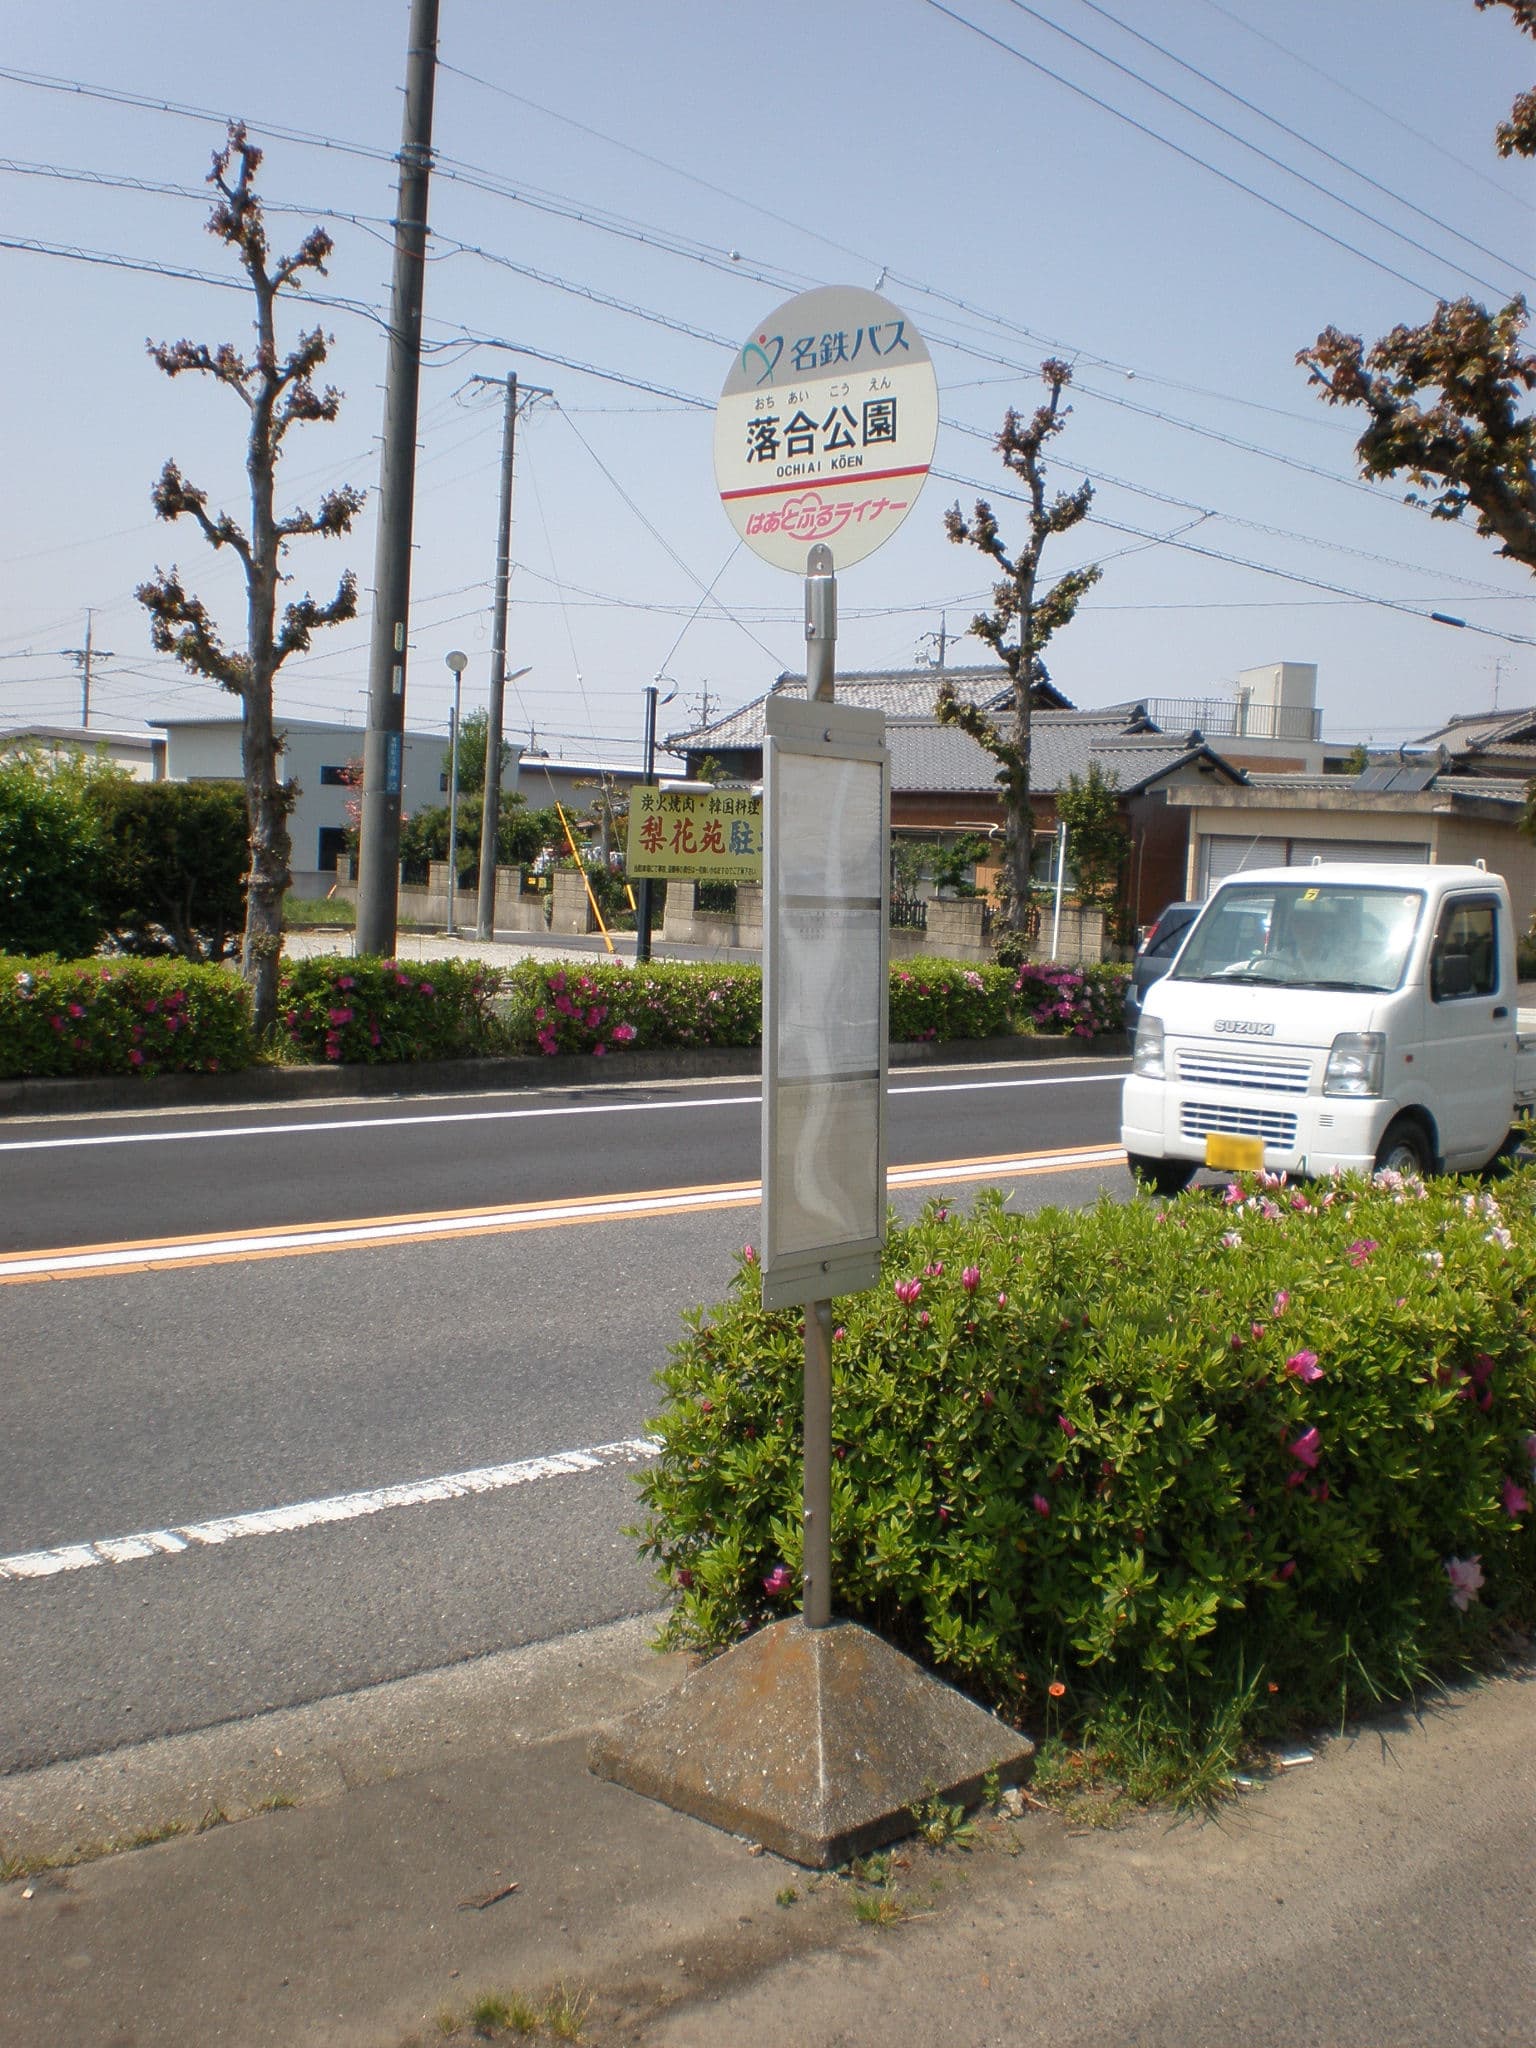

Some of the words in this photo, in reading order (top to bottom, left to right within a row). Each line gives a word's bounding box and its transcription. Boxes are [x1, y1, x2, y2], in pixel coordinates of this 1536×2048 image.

[790, 320, 909, 372] 名鉄バス
[754, 396, 775, 410] おち
[787, 391, 809, 405] あい
[829, 383, 850, 397] こう
[869, 376, 891, 390] えん
[746, 397, 897, 464] 落合公園
[776, 461, 821, 477] OCHIAI
[831, 455, 863, 470] KŌEN
[746, 497, 907, 536] はあとふるライナー
[639, 815, 763, 855] 梨花苑駐
[1214, 1019, 1275, 1037] SUZUKI
